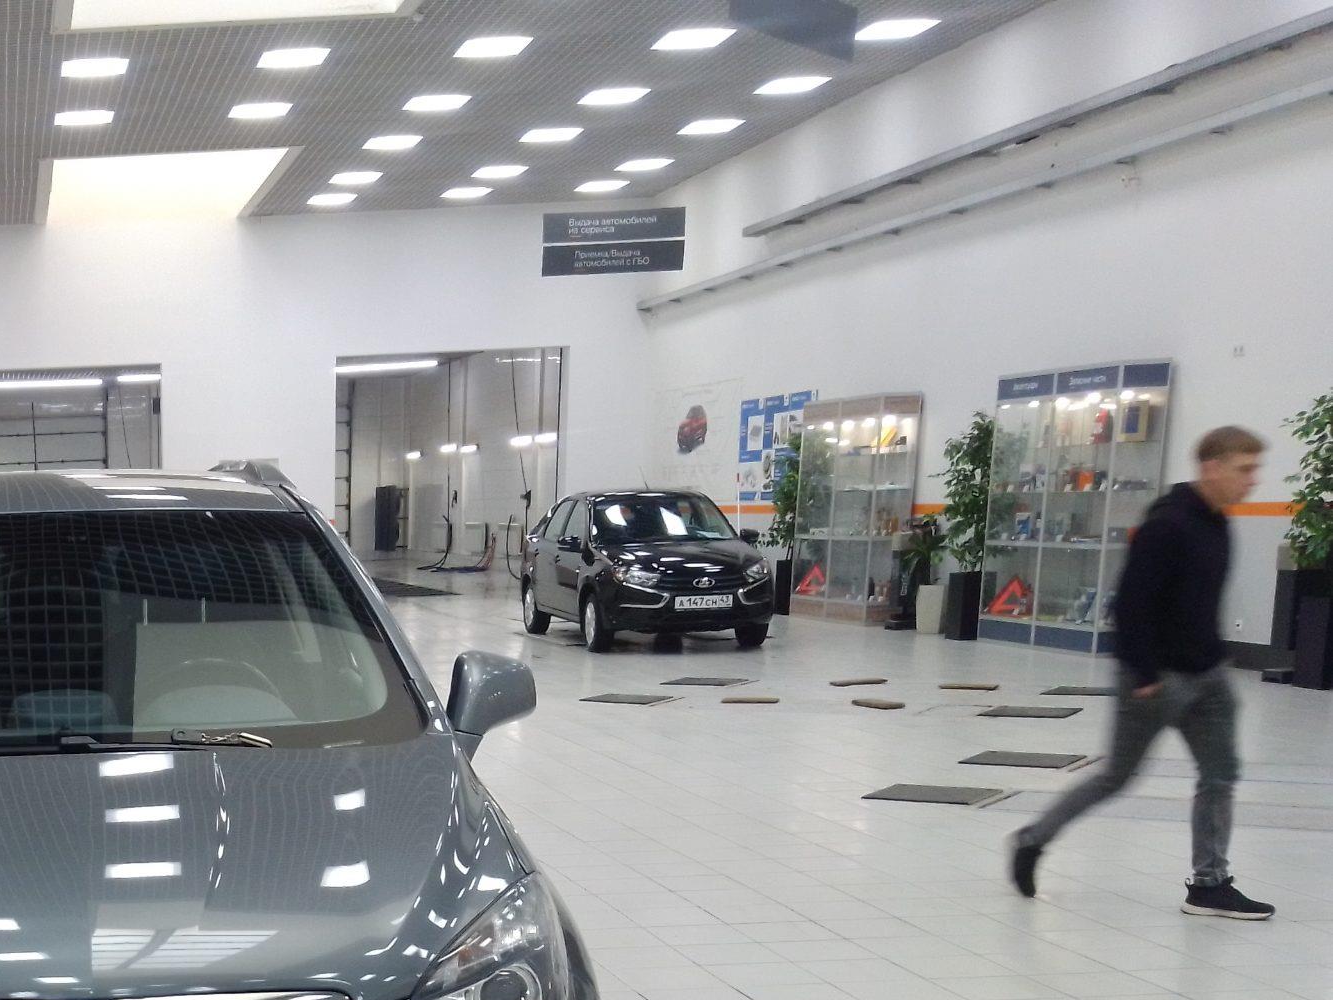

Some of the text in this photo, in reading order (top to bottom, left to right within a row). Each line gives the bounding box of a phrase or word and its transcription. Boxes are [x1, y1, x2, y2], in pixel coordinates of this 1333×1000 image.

[568, 216, 657, 227] Выдача автомобилей
[632, 256, 650, 266] ГБО
